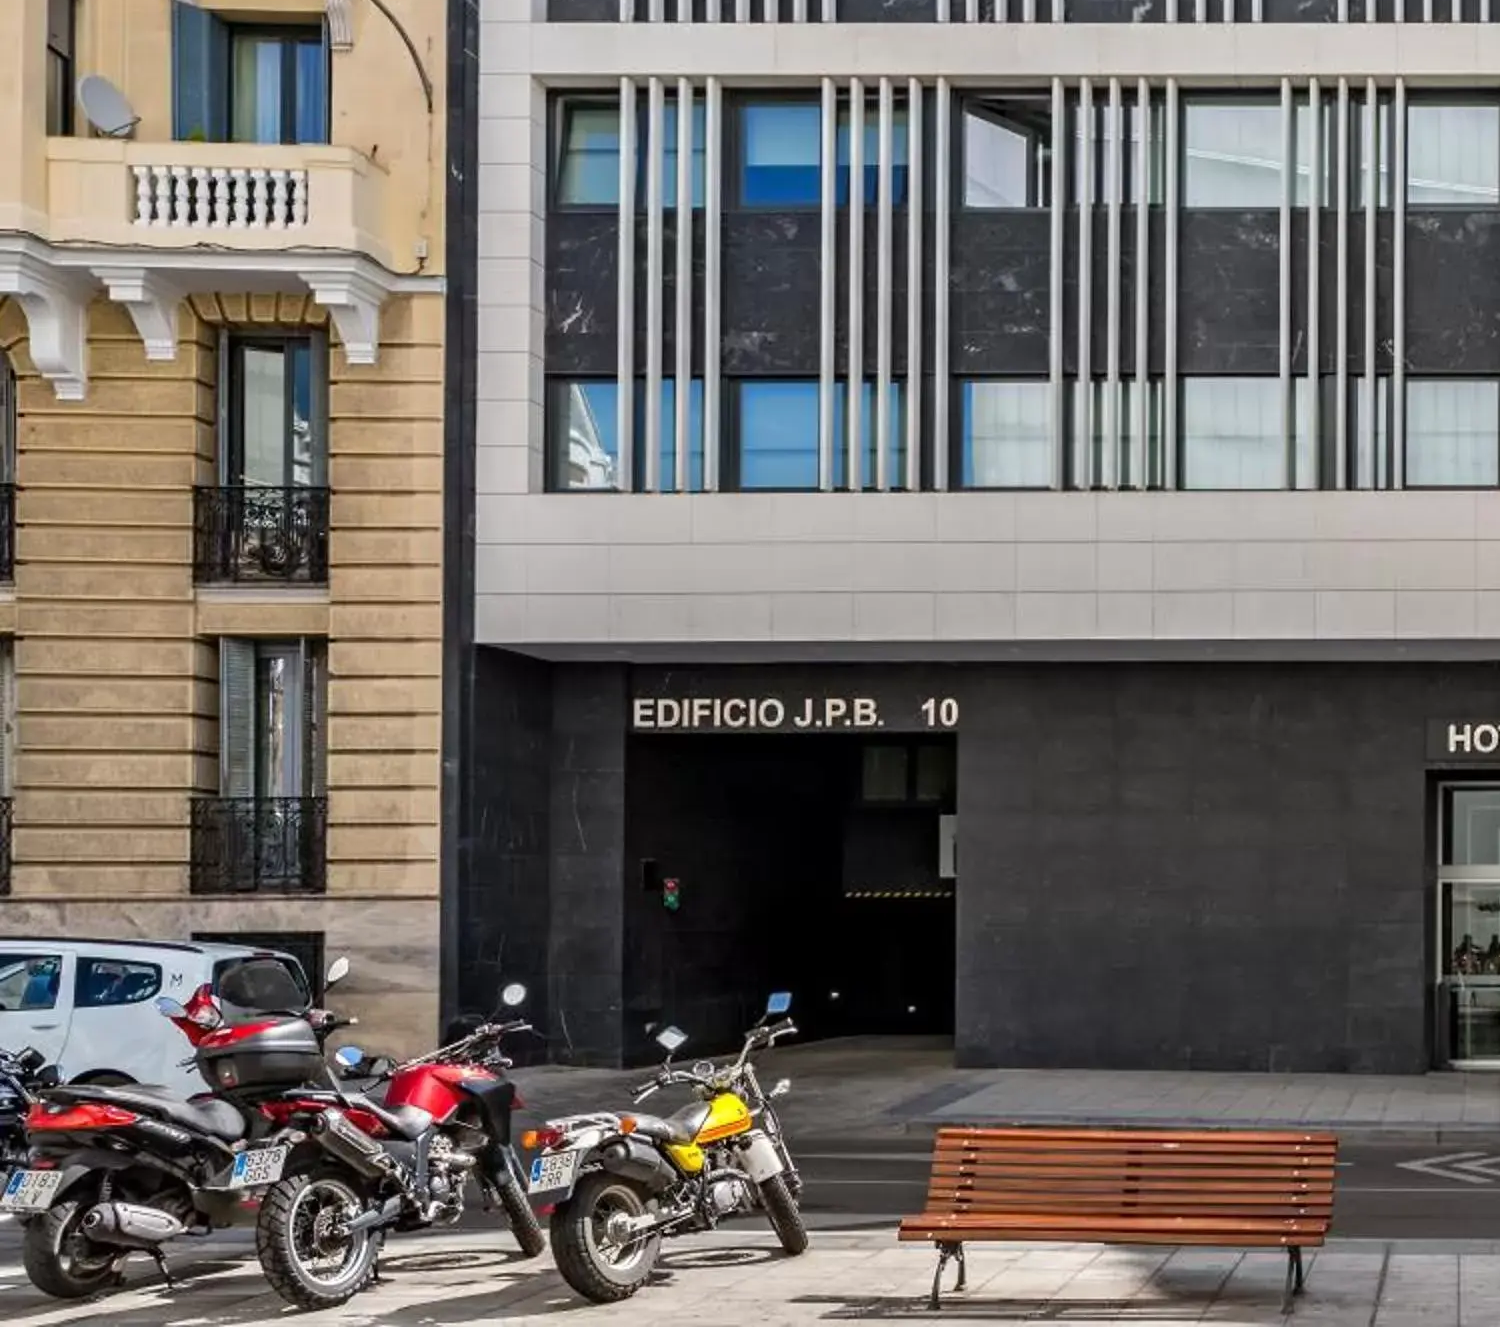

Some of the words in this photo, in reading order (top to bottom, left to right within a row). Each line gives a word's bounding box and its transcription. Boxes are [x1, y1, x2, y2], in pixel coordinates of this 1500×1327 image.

[633, 698, 784, 728] EDIFICIO
[794, 698, 885, 728] J.P.B.
[921, 697, 959, 727] 10
